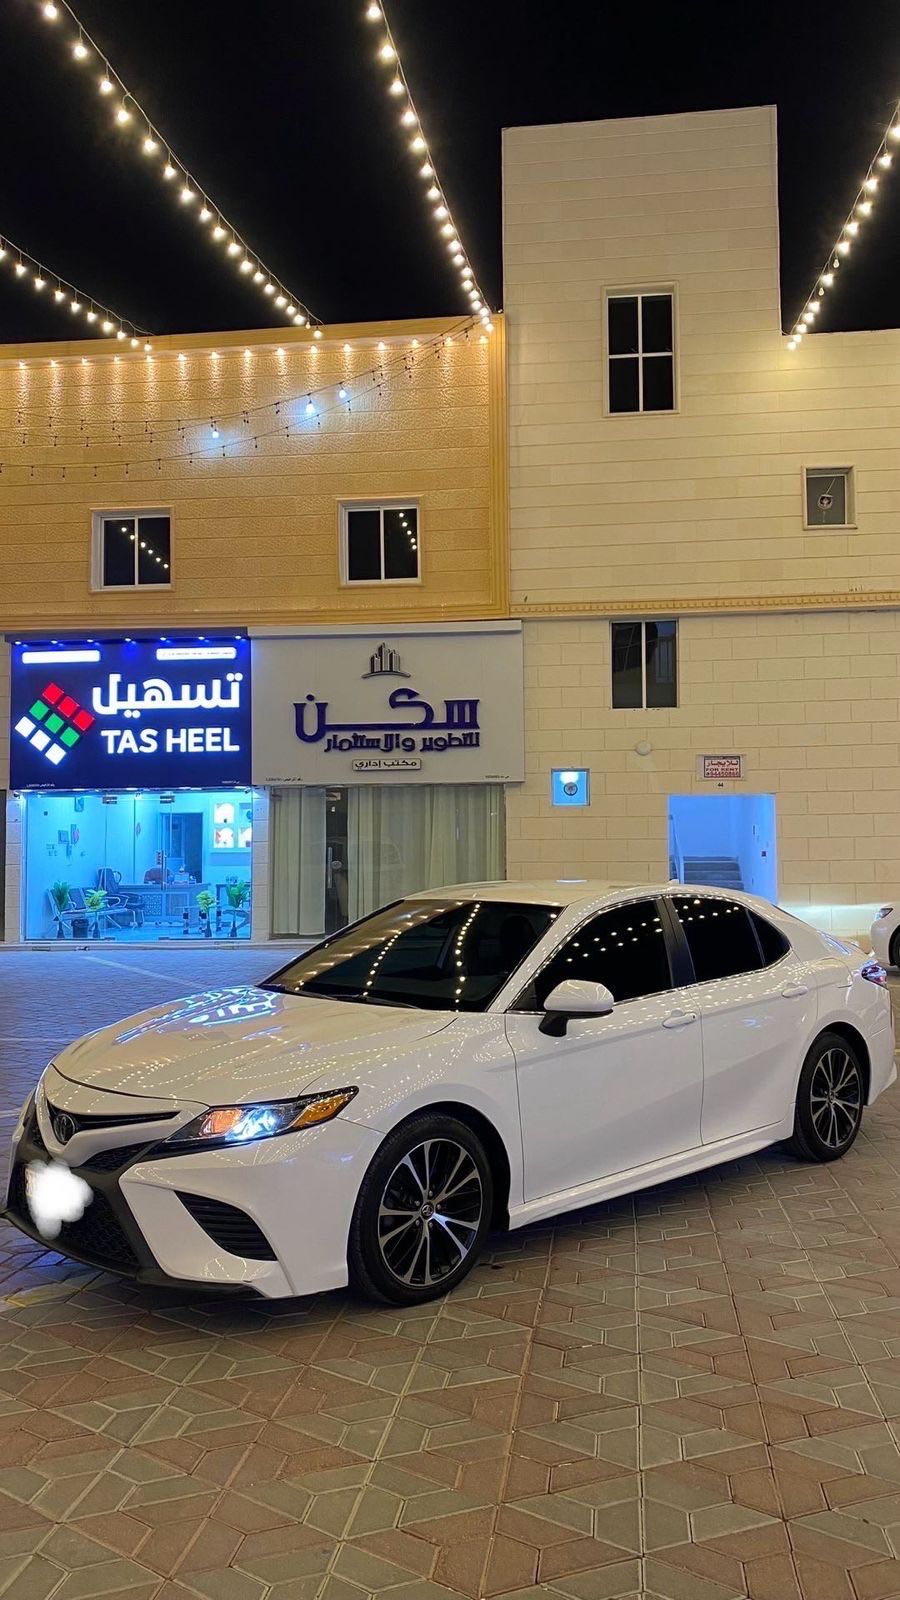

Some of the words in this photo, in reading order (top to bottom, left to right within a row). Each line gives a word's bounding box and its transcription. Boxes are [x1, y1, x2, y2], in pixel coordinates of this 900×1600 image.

[92, 672, 243, 718] تسهيل
[293, 687, 480, 743] سكن
[100, 729, 158, 754] TAS
[165, 727, 240, 753] HEEL
[420, 732, 480, 753] للتطوير
[355, 760, 381, 770] إداري
[383, 759, 417, 767] مكتب
